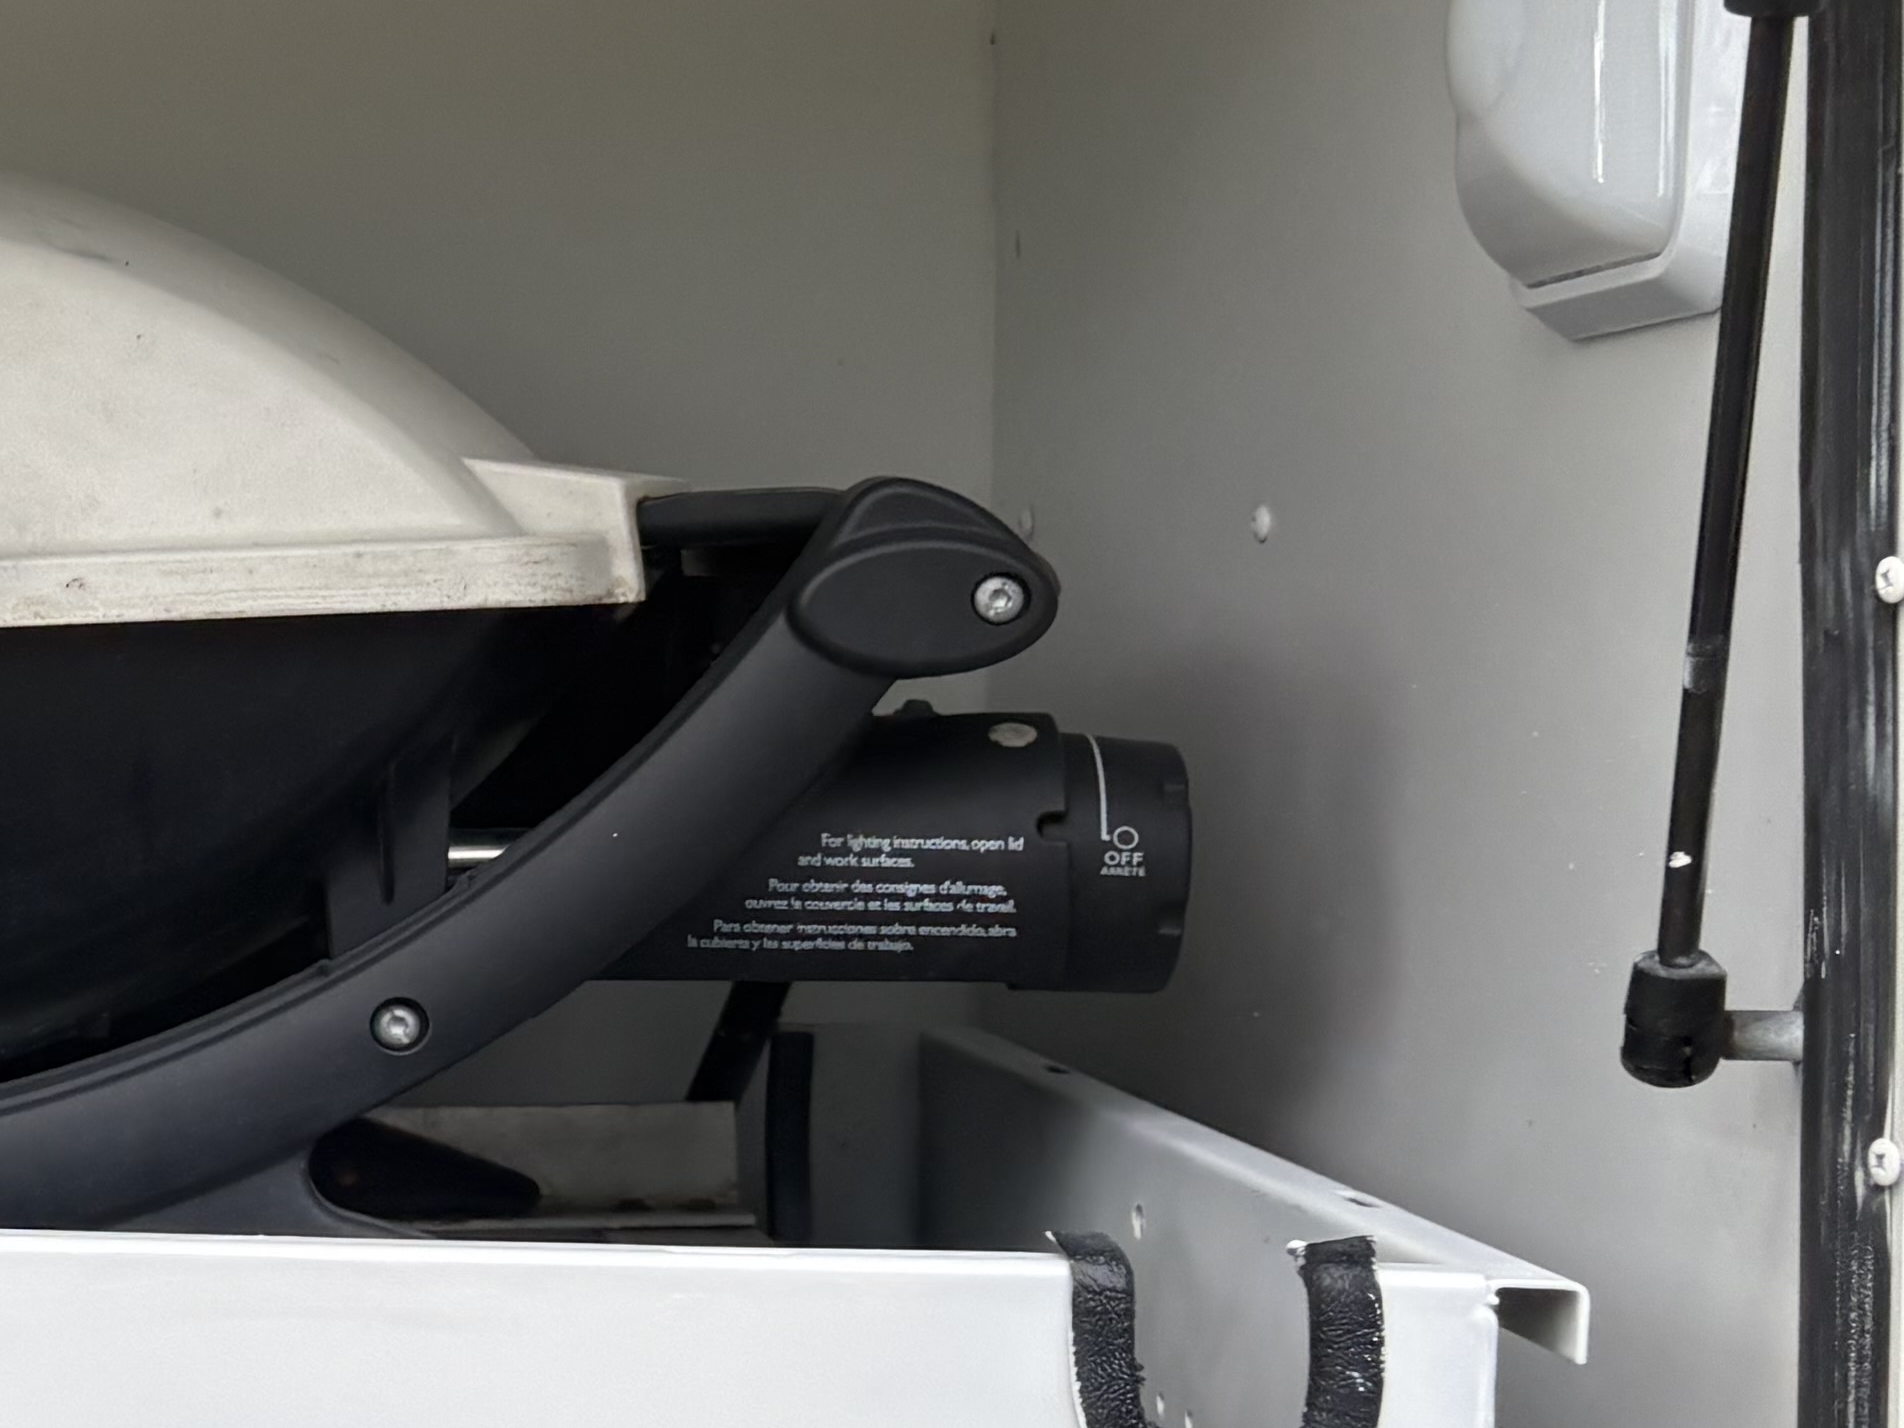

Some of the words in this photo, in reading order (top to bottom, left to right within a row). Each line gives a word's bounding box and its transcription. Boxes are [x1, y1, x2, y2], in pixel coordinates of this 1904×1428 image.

[821, 833, 844, 847] For
[847, 833, 891, 852] lighting
[971, 839, 1004, 853] open
[1008, 836, 1024, 851] lid
[798, 853, 821, 866] and
[824, 854, 858, 867] work
[1104, 850, 1144, 865] OFF
[768, 878, 798, 892] Pour
